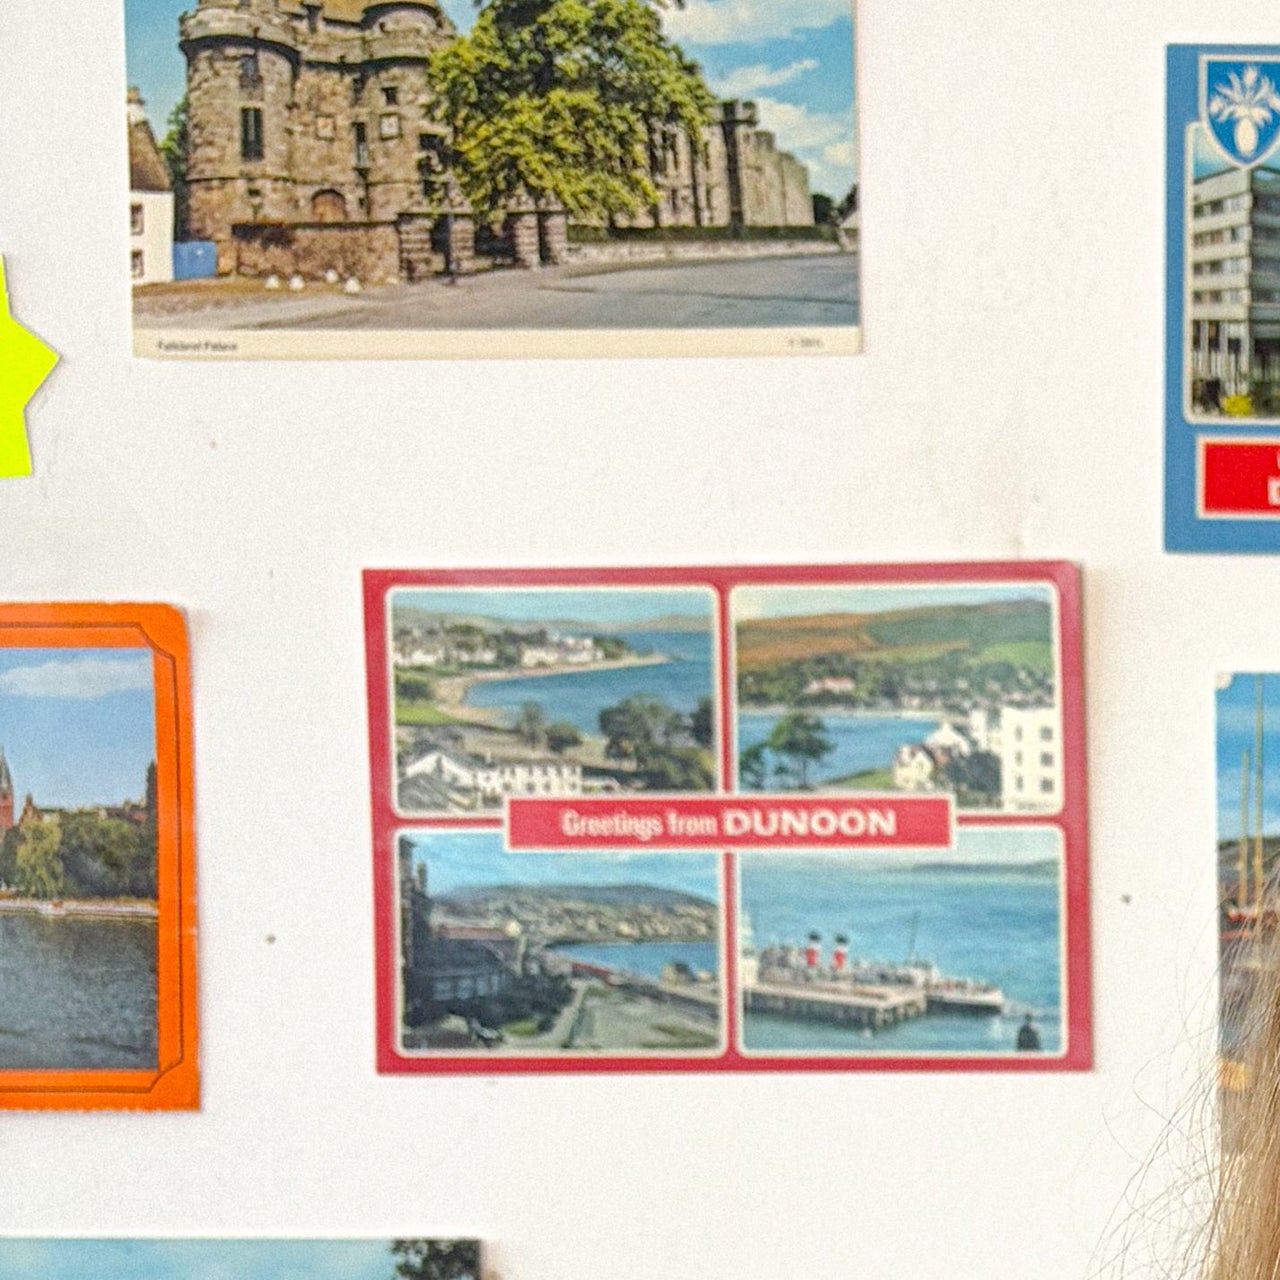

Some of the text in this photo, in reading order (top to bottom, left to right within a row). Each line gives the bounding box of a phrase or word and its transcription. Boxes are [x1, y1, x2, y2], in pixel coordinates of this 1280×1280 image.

[561, 807, 897, 841] Greetings from DUNOON
